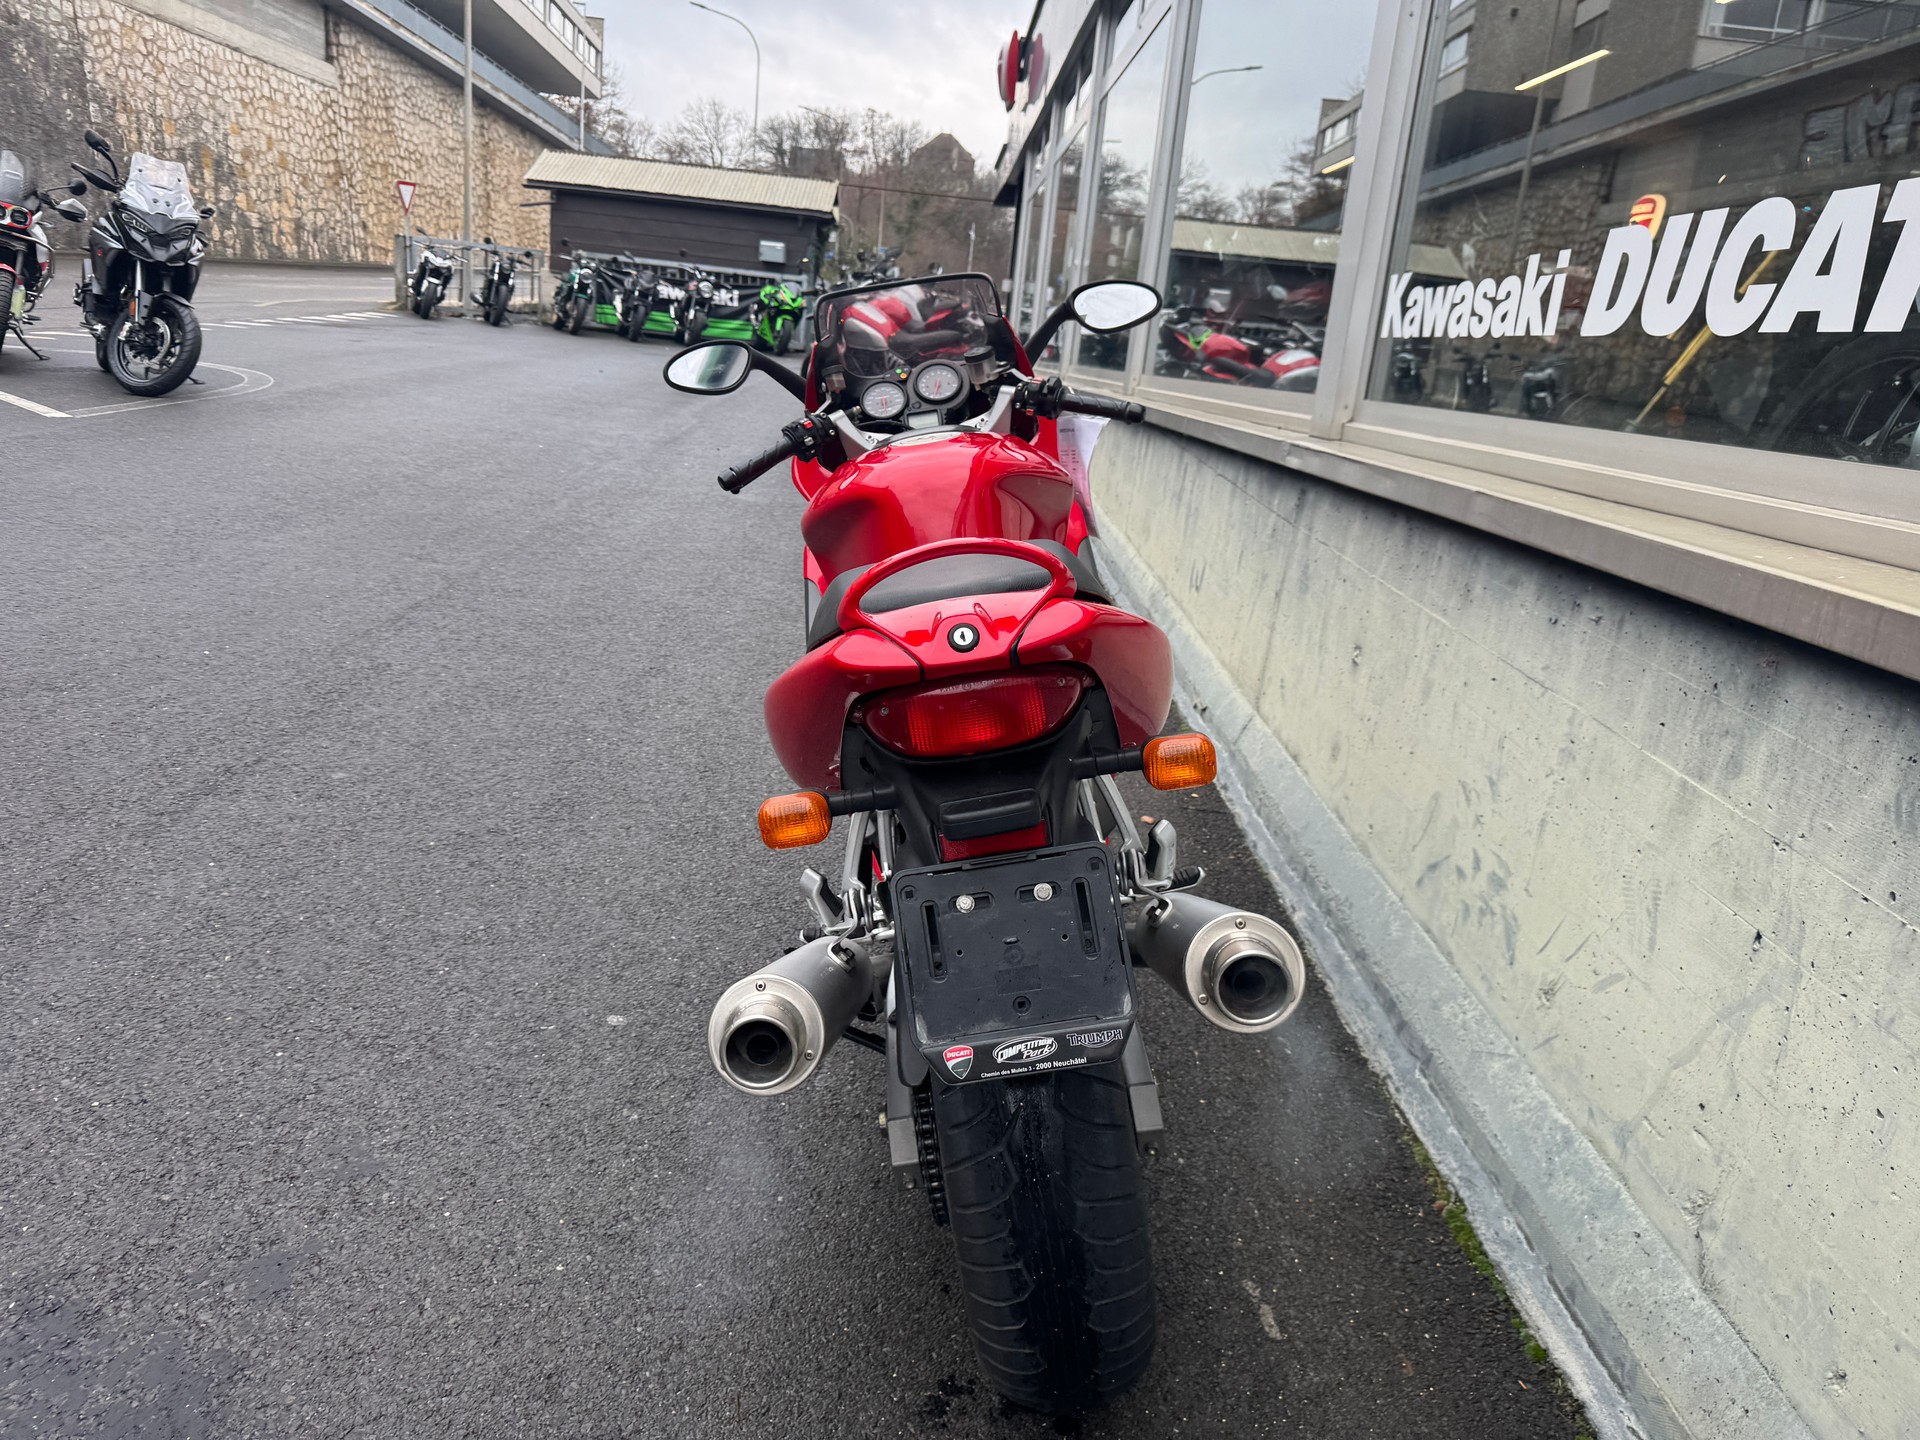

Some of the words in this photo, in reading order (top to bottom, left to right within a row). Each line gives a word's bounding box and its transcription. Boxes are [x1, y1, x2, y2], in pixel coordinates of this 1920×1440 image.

[1381, 248, 1572, 339] Kawasaki
[1066, 1029, 1123, 1047] TRIUMPH
[946, 1049, 970, 1058] DUCATI
[1023, 1045, 1052, 1059] Park
[1011, 1066, 1028, 1074] Mulets
[1036, 1062, 1052, 1071] 2000
[1053, 1057, 1087, 1066] Neuchâtel
